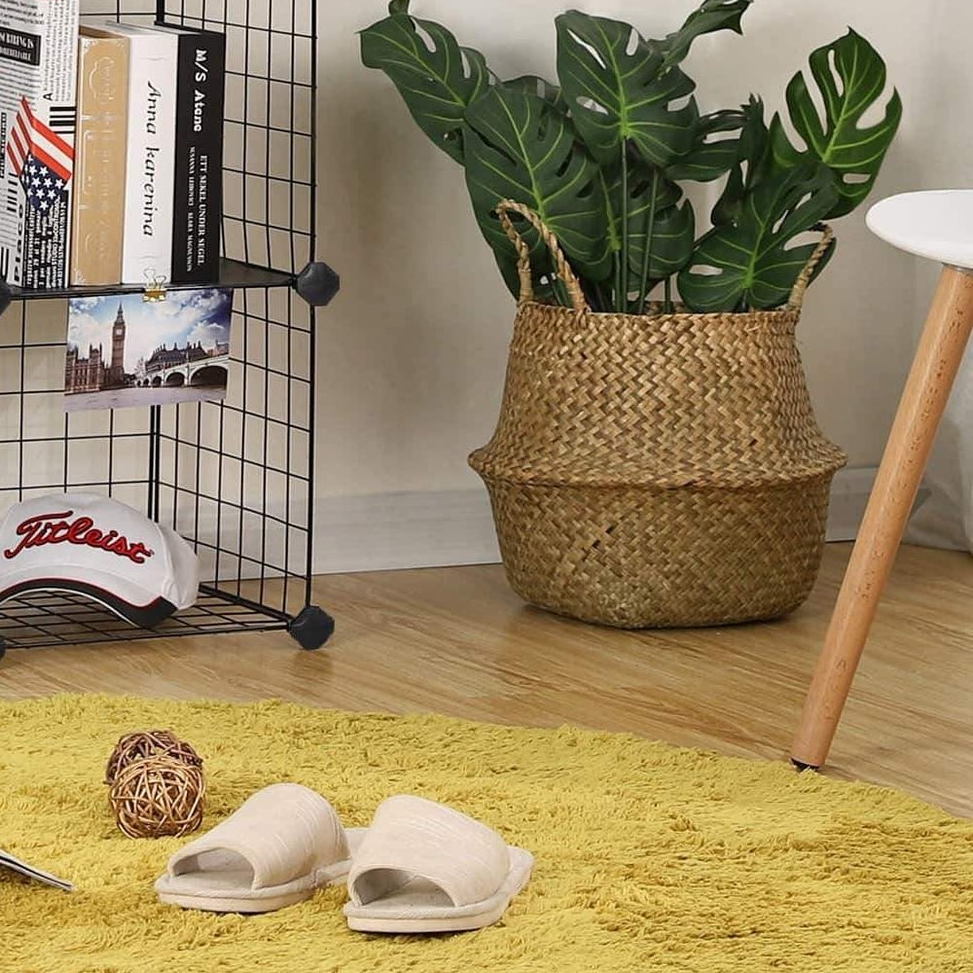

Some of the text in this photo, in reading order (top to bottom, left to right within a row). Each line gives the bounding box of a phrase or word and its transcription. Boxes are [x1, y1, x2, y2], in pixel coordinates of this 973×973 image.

[194, 48, 209, 83] M/S
[145, 80, 162, 135] Anna
[199, 155, 208, 173] ETT
[197, 204, 207, 236] UNDER
[3, 510, 153, 564] Titleist
